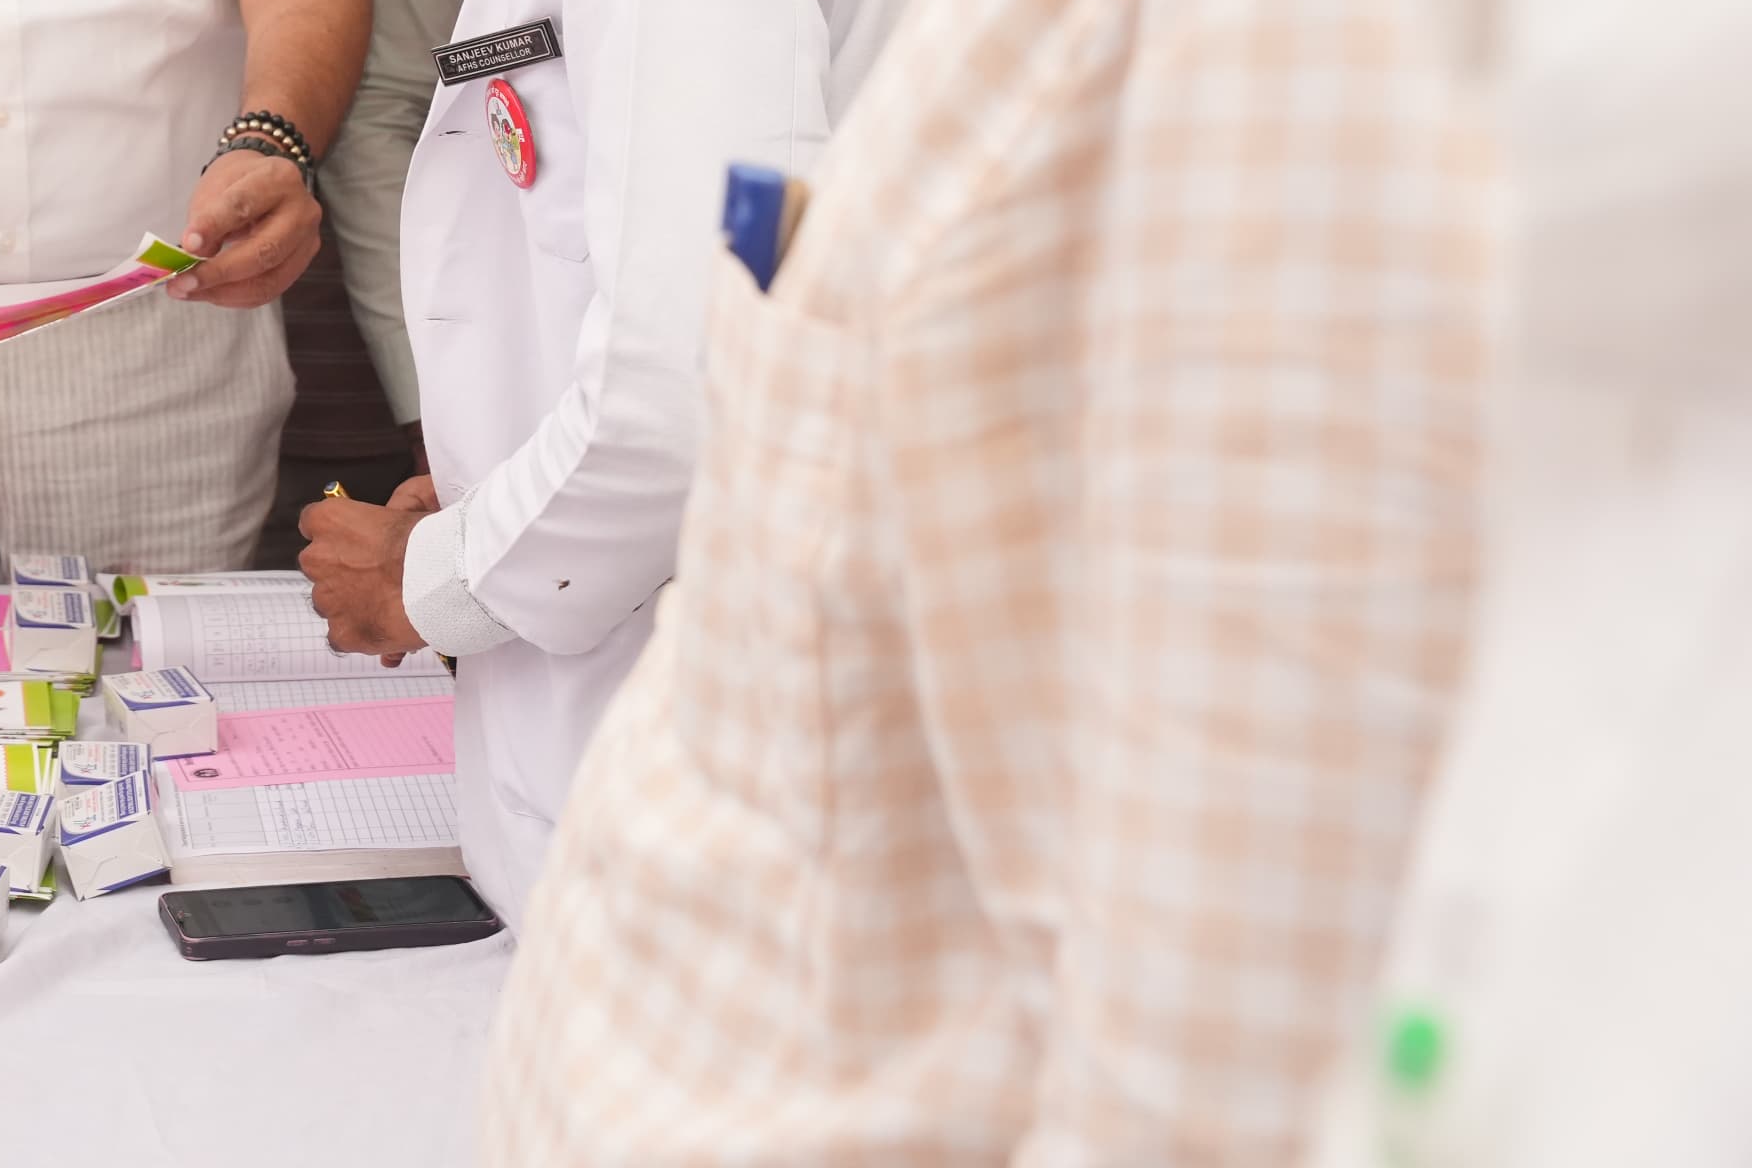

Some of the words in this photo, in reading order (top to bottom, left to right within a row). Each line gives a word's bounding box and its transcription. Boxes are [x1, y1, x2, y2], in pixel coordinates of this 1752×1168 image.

[449, 45, 494, 64] SANJEEV
[495, 35, 533, 52] KUMAR
[457, 61, 479, 73] AFHS
[479, 47, 532, 67] COUNSELLOR
